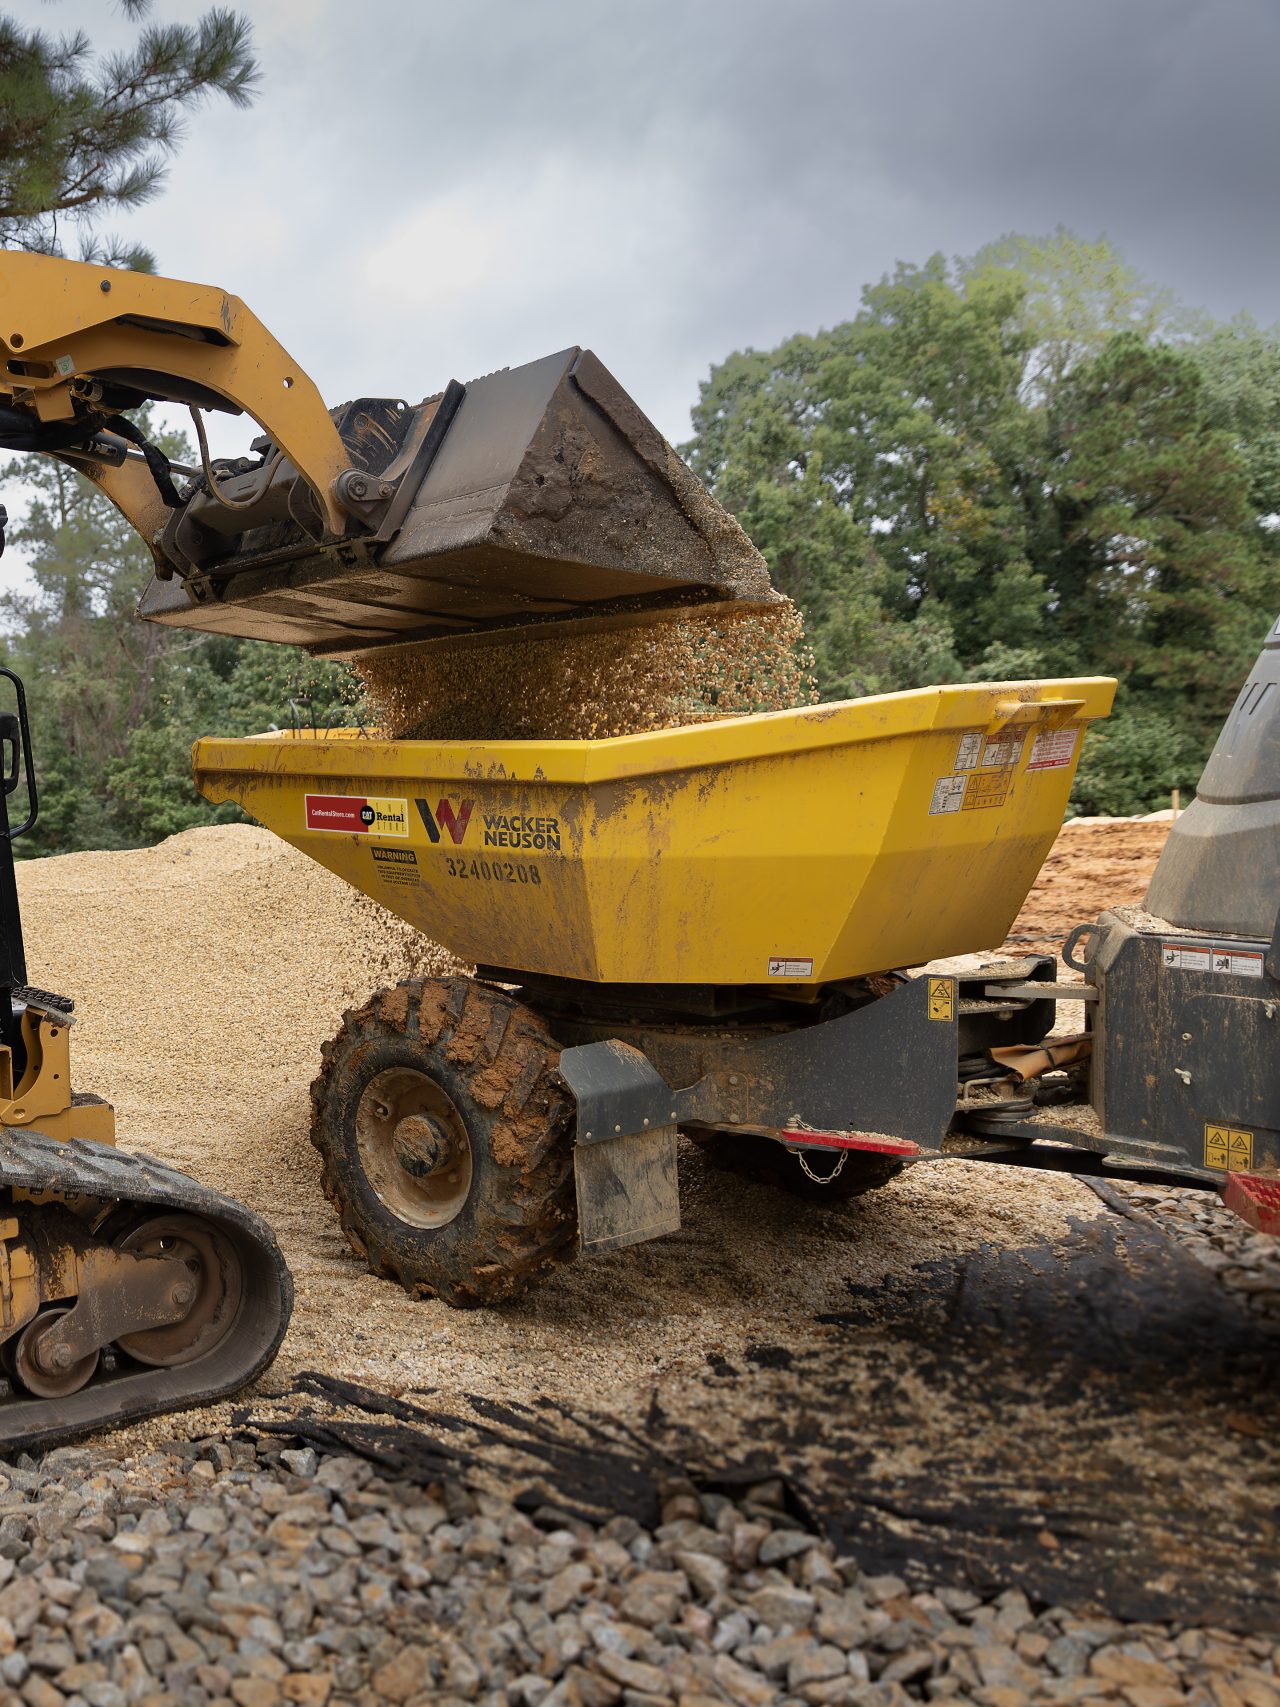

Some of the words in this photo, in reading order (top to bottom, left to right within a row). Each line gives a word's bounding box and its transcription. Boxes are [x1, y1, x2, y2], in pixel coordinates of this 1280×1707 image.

[362, 811, 373, 820] CAT
[376, 812, 405, 822] Rental
[482, 815, 560, 834] WACKER
[484, 831, 561, 851] NEUSON
[373, 849, 415, 862] WARNING
[446, 857, 542, 885] 32400208
